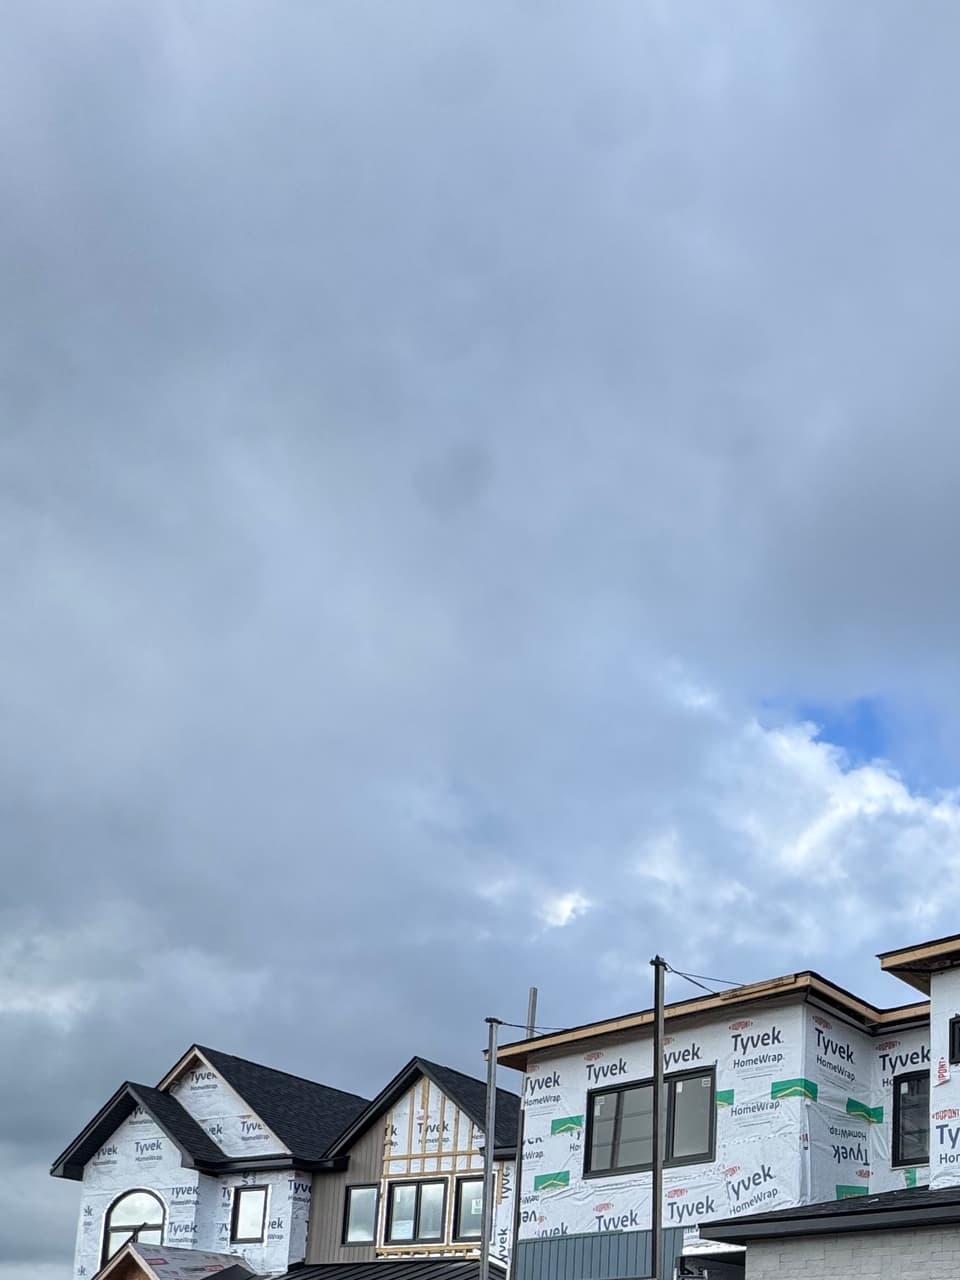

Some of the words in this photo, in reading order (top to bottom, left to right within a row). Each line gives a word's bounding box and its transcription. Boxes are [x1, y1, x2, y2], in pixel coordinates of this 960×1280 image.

[731, 1026, 782, 1055] Tyvek
[815, 1028, 854, 1064] Tyvek
[586, 1058, 627, 1084] Tyvek
[664, 1043, 701, 1071] yvek
[879, 1045, 930, 1075] Tyvek
[135, 1140, 162, 1155] Tyvek
[667, 1195, 715, 1224] Tyvek
